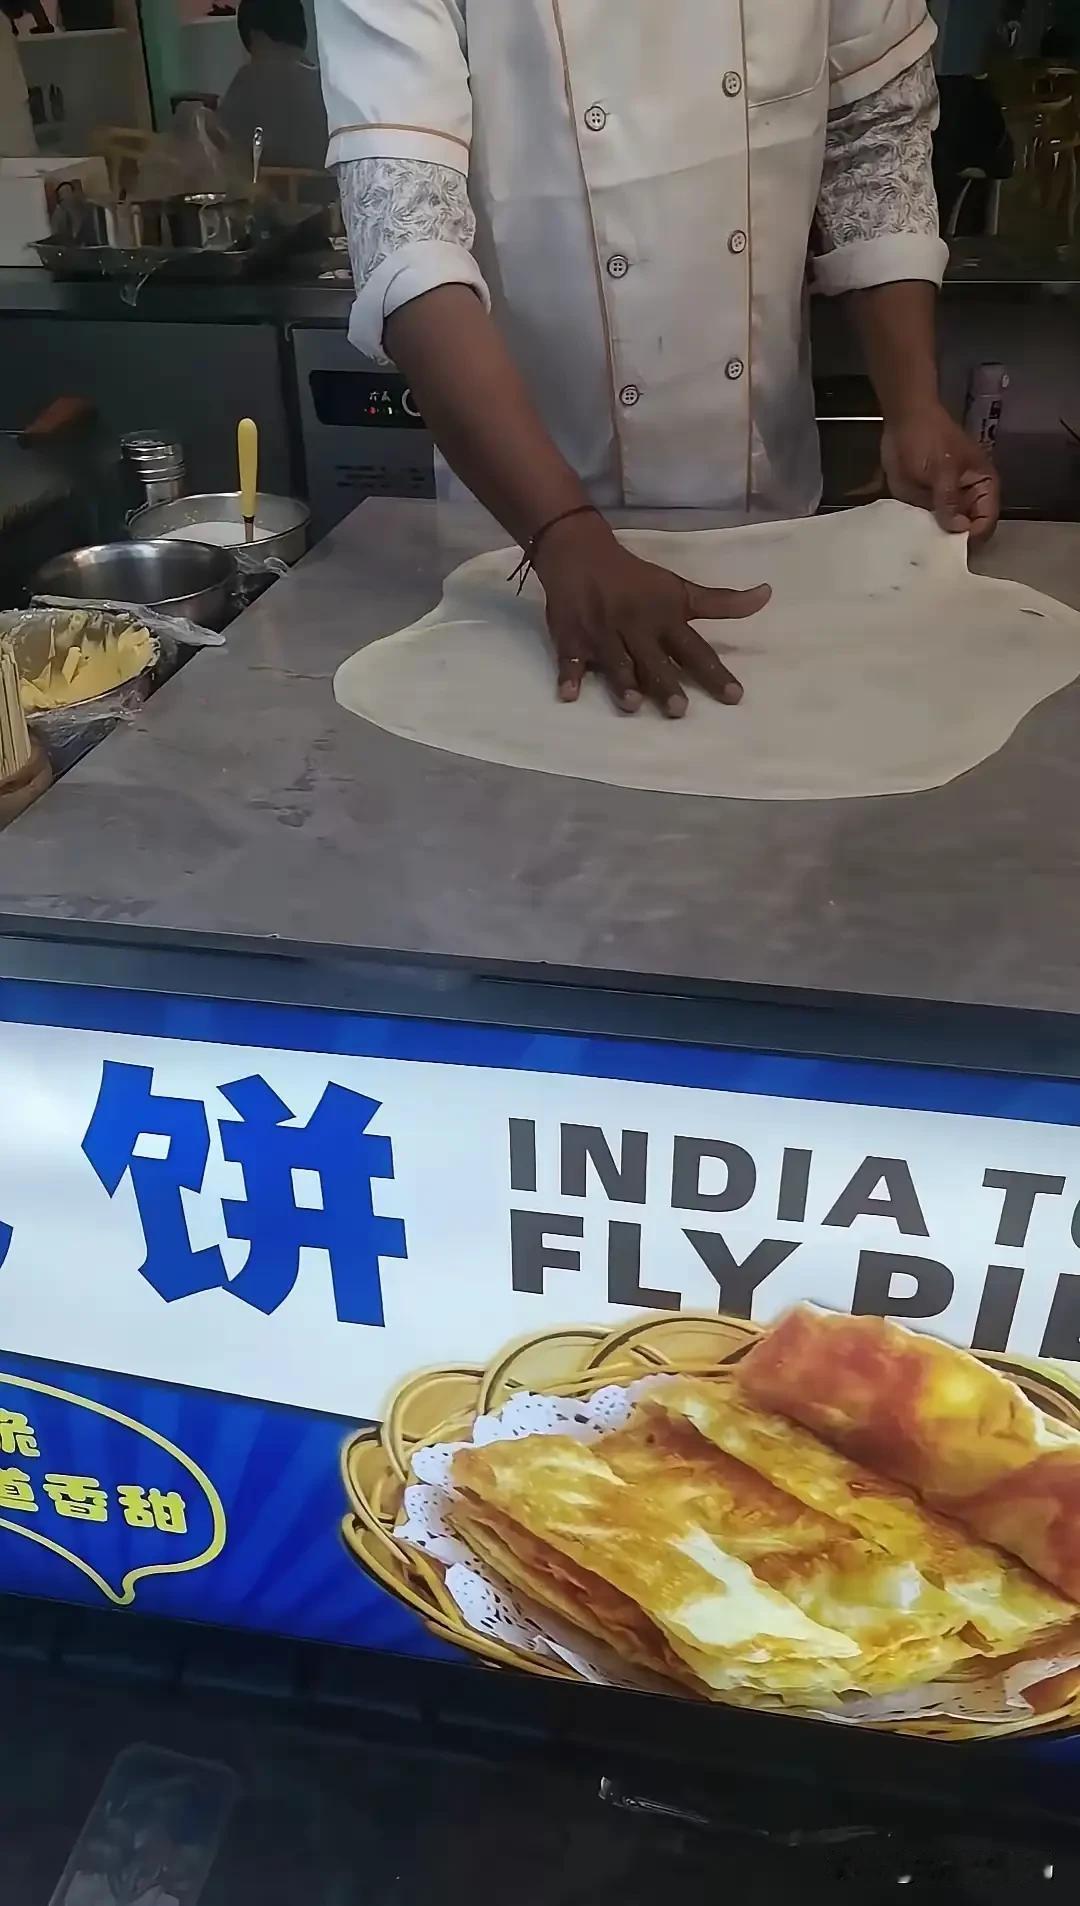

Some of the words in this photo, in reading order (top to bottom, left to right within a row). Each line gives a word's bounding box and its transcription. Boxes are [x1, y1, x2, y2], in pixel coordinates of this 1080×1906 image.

[0, 1060, 408, 1327] 饼
[508, 1117, 930, 1237] INDIA
[981, 1167, 1080, 1249] T
[510, 1209, 803, 1320] FLY
